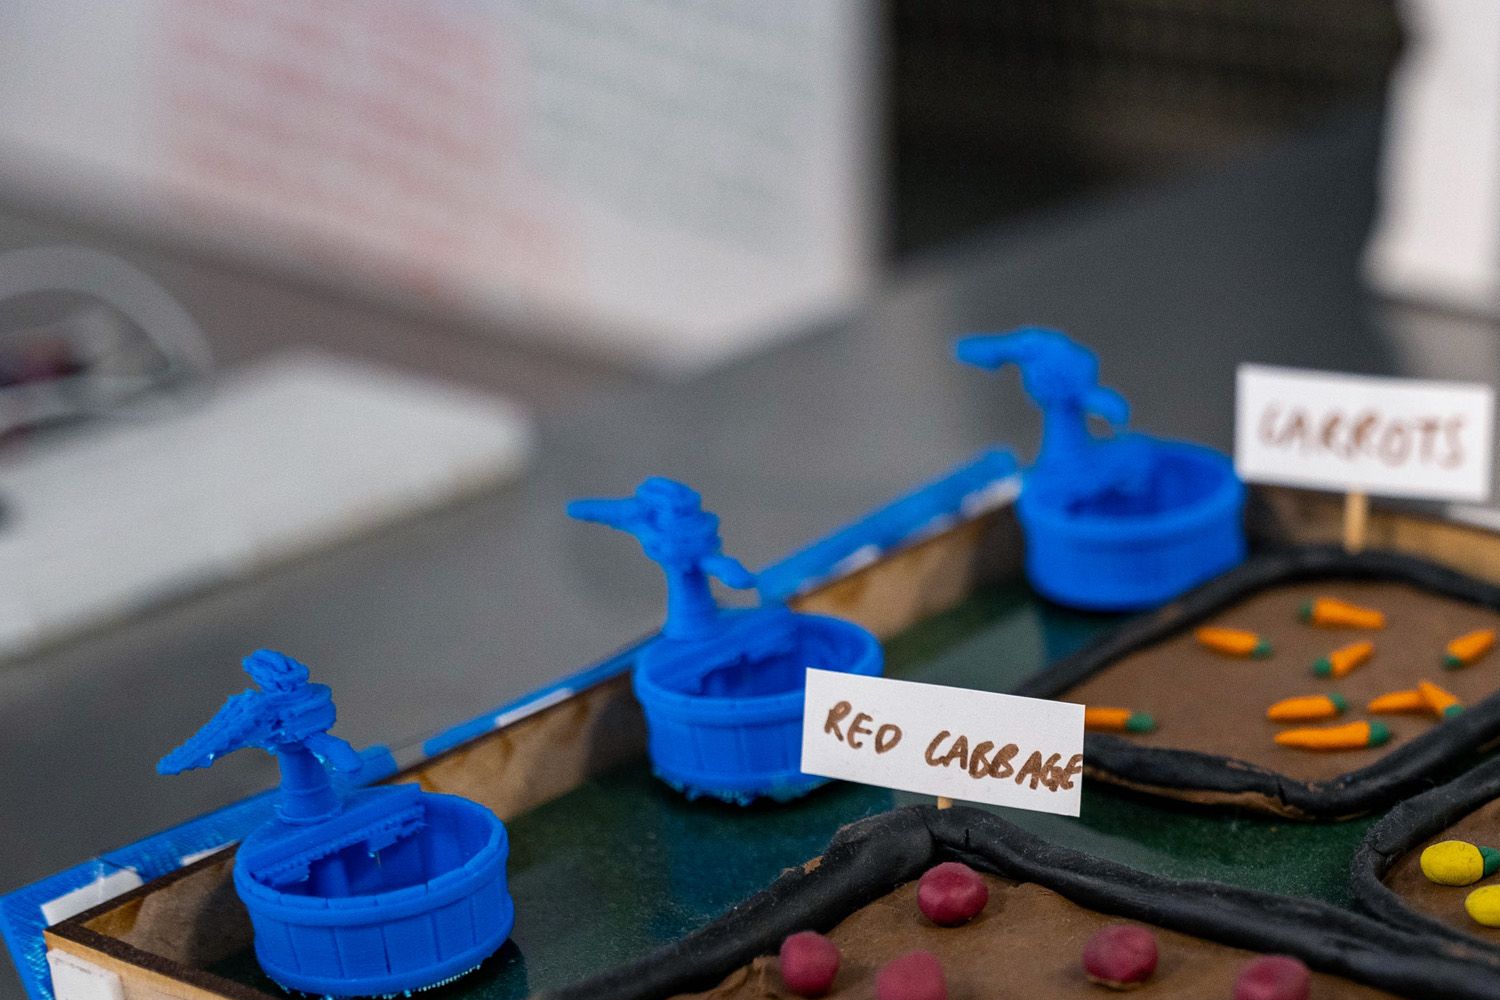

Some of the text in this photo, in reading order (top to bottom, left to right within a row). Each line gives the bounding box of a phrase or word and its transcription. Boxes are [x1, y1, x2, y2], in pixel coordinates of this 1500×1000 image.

[1257, 401, 1469, 471] CARROTS
[823, 700, 1083, 792] RED CABBAGE
